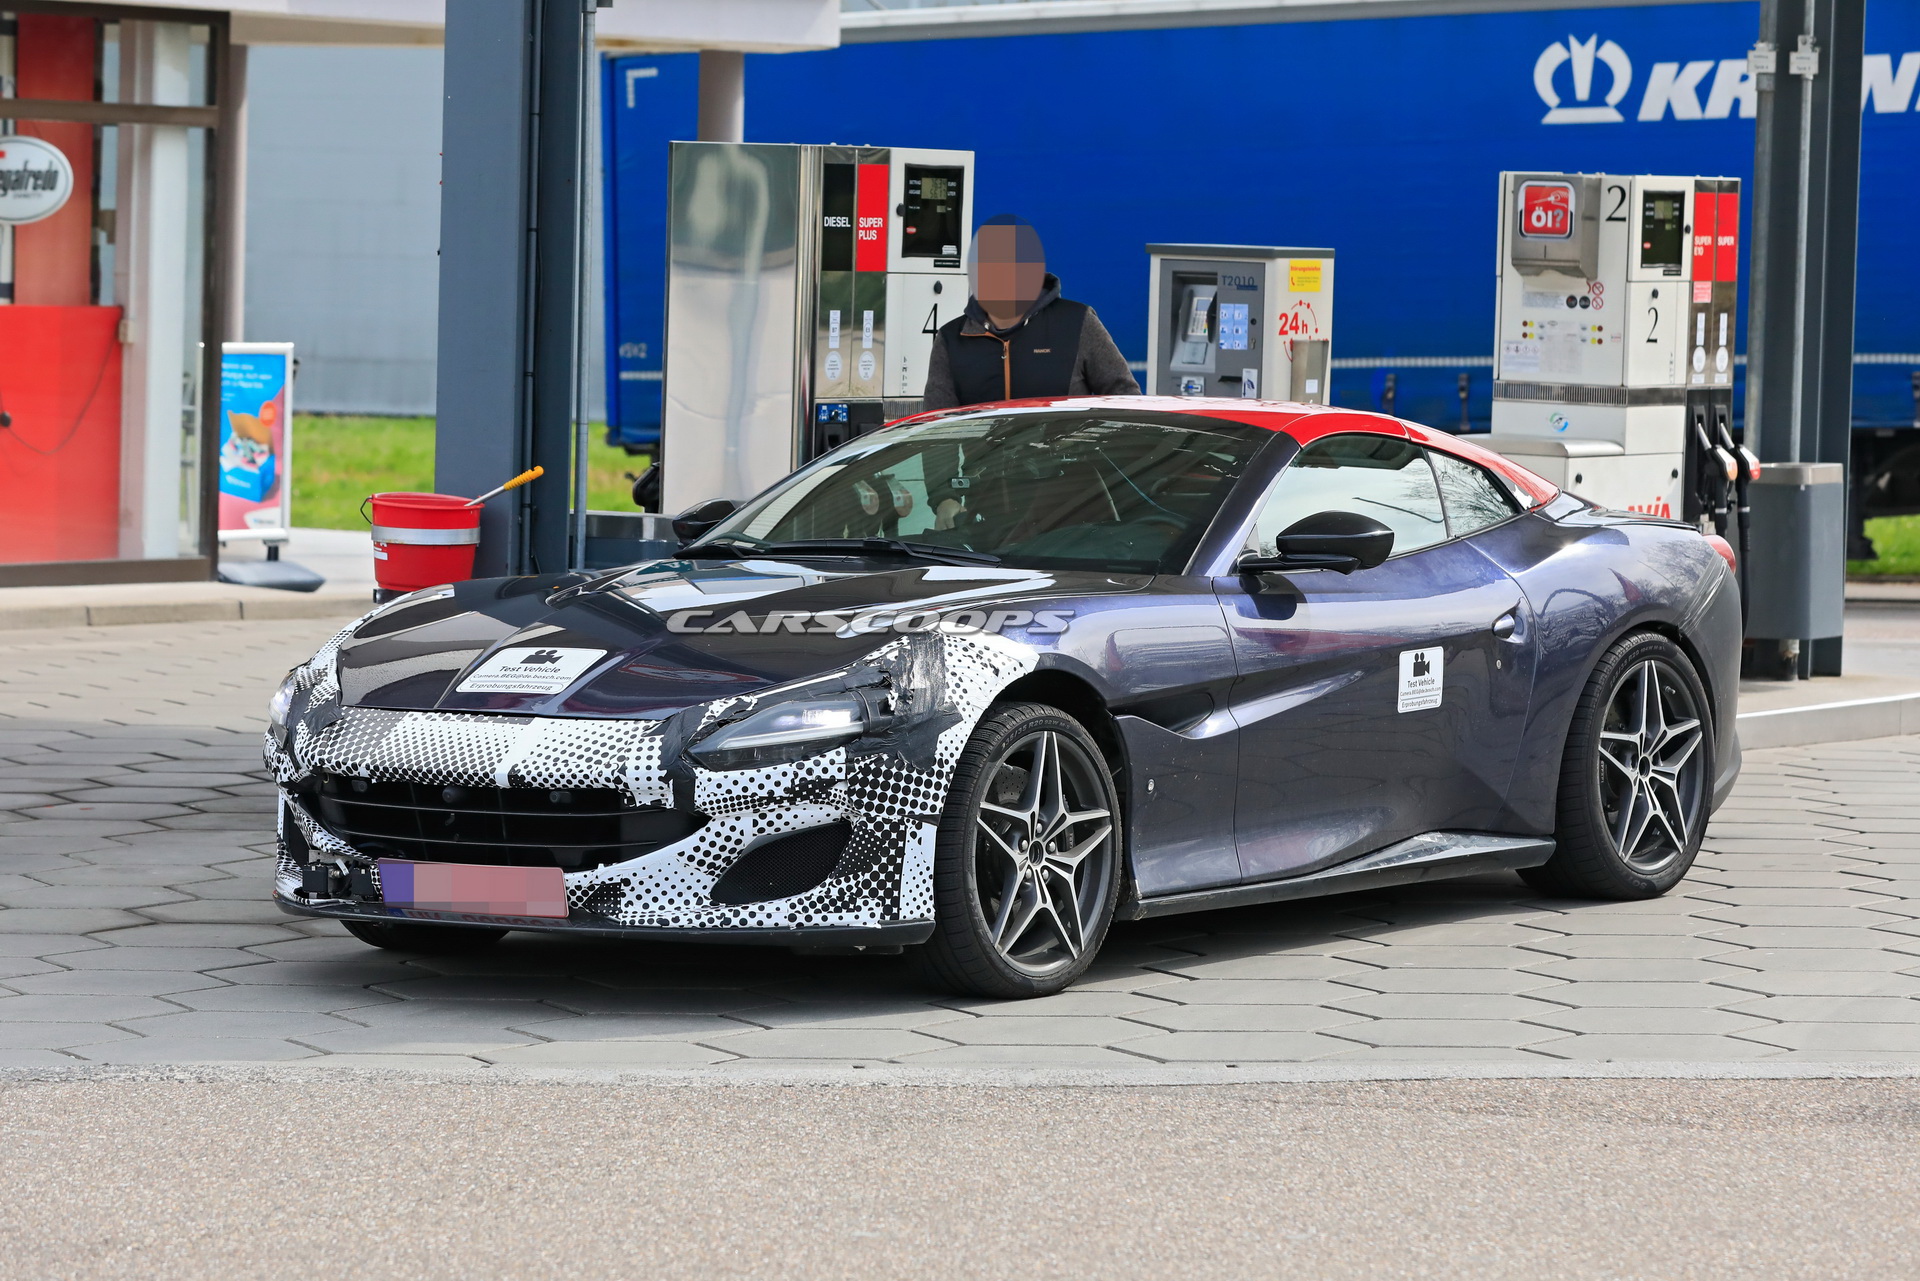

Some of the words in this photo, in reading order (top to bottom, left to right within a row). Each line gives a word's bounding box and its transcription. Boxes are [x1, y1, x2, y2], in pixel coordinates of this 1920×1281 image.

[1605, 185, 1627, 222] 2
[823, 216, 851, 227] DIESEL
[858, 217, 883, 228] SUPER
[1531, 206, 1564, 228] Öl?
[858, 229, 877, 240] PLUS
[1694, 236, 1712, 246] SUPER
[1717, 236, 1734, 246] SUPER
[1693, 246, 1704, 256] E10
[1221, 275, 1255, 287] T2010
[922, 303, 938, 342] 4
[1646, 307, 1659, 343] 2
[469, 683, 553, 691] Erprobungsfahrzeug
[1407, 680, 1418, 688] Test
[1418, 677, 1435, 687] Vehicle
[1028, 719, 1043, 728] R20
